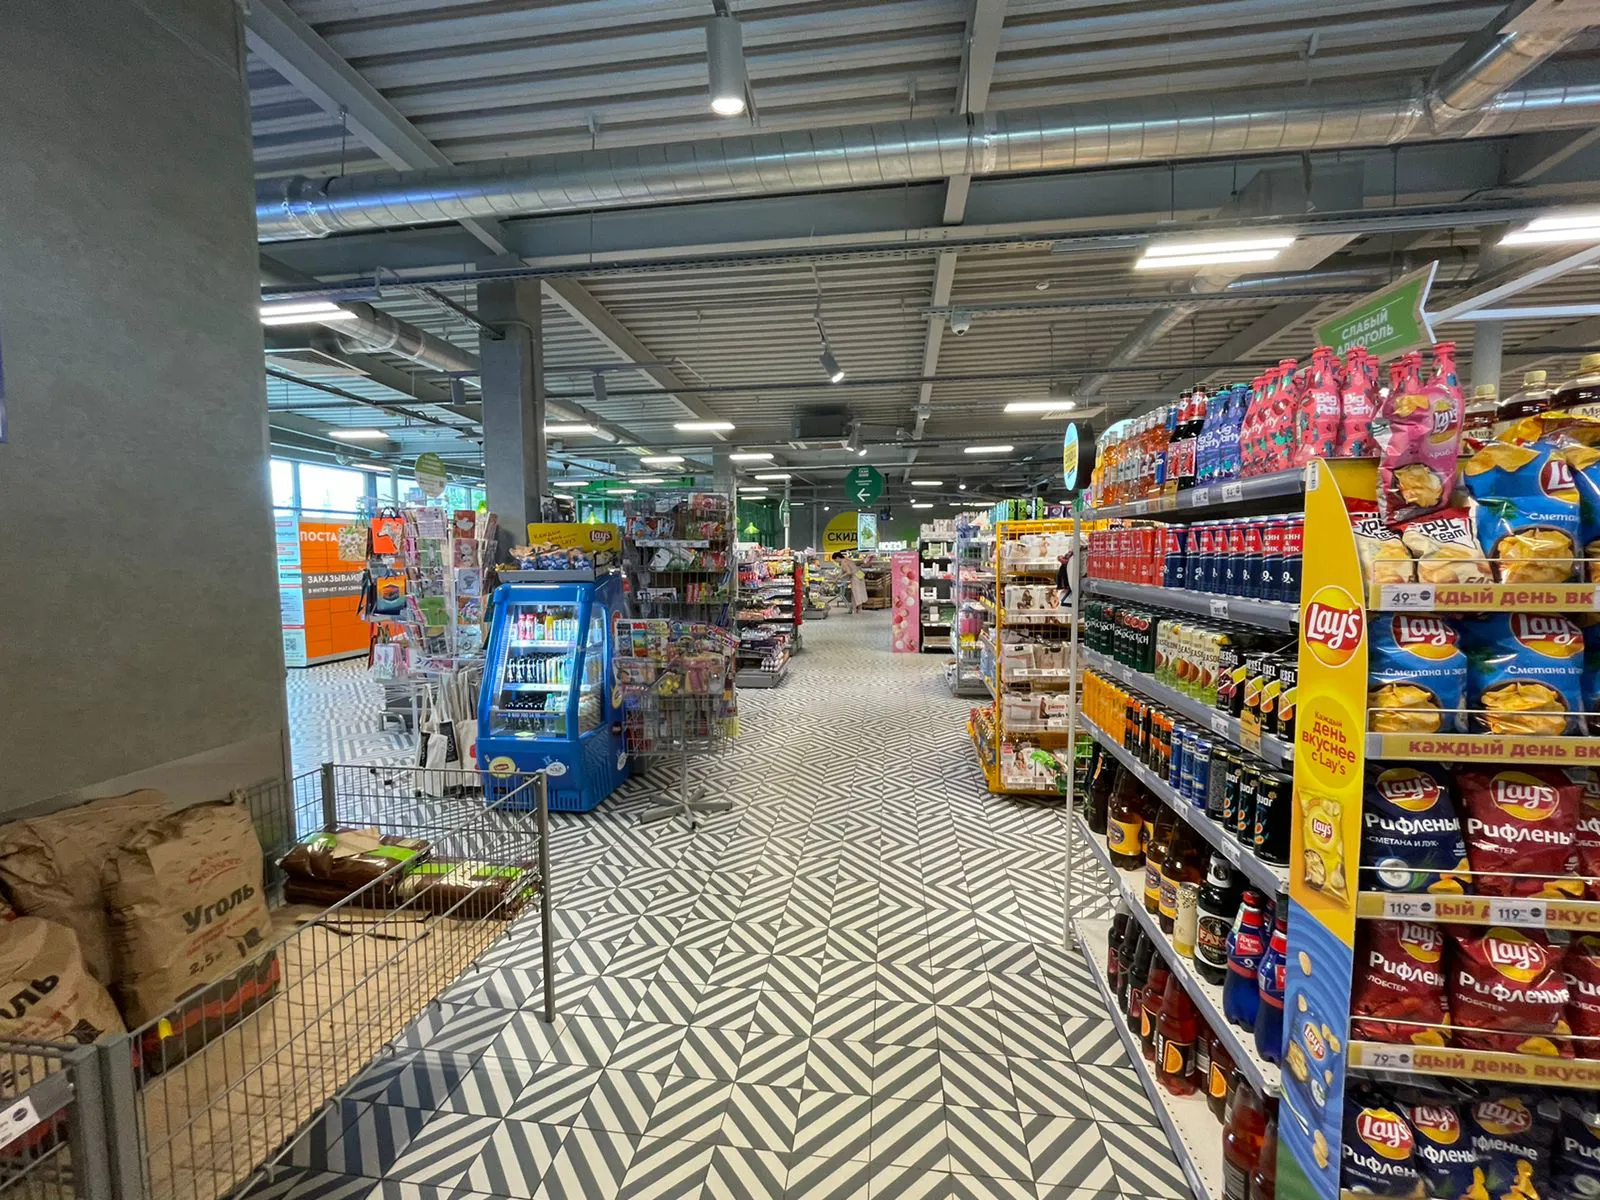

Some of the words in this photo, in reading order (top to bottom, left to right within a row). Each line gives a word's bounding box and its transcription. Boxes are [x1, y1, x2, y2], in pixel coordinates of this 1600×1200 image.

[1342, 308, 1388, 340] СЛАБЫЙ
[1336, 324, 1393, 356] АЛКОГОЛЬ
[1316, 392, 1337, 406] Big
[1344, 404, 1374, 418] Party
[1392, 593, 1409, 603] 49
[1501, 591, 1558, 606] день
[1307, 604, 1361, 649] Lay's
[1315, 710, 1343, 728] Каждый
[1313, 721, 1347, 744] день
[1302, 730, 1357, 764] вкуснее
[1408, 740, 1504, 757] каждый
[1510, 744, 1567, 758] день
[1312, 751, 1318, 761] с
[1319, 752, 1346, 775] Lay's
[1312, 818, 1333, 837] Lay's
[182, 884, 255, 934] Уголь
[1391, 903, 1411, 915] 119
[1498, 908, 1520, 919] 119
[1489, 938, 1541, 970] Lay's
[1373, 1053, 1389, 1064] 79
[1472, 1060, 1527, 1076] день
